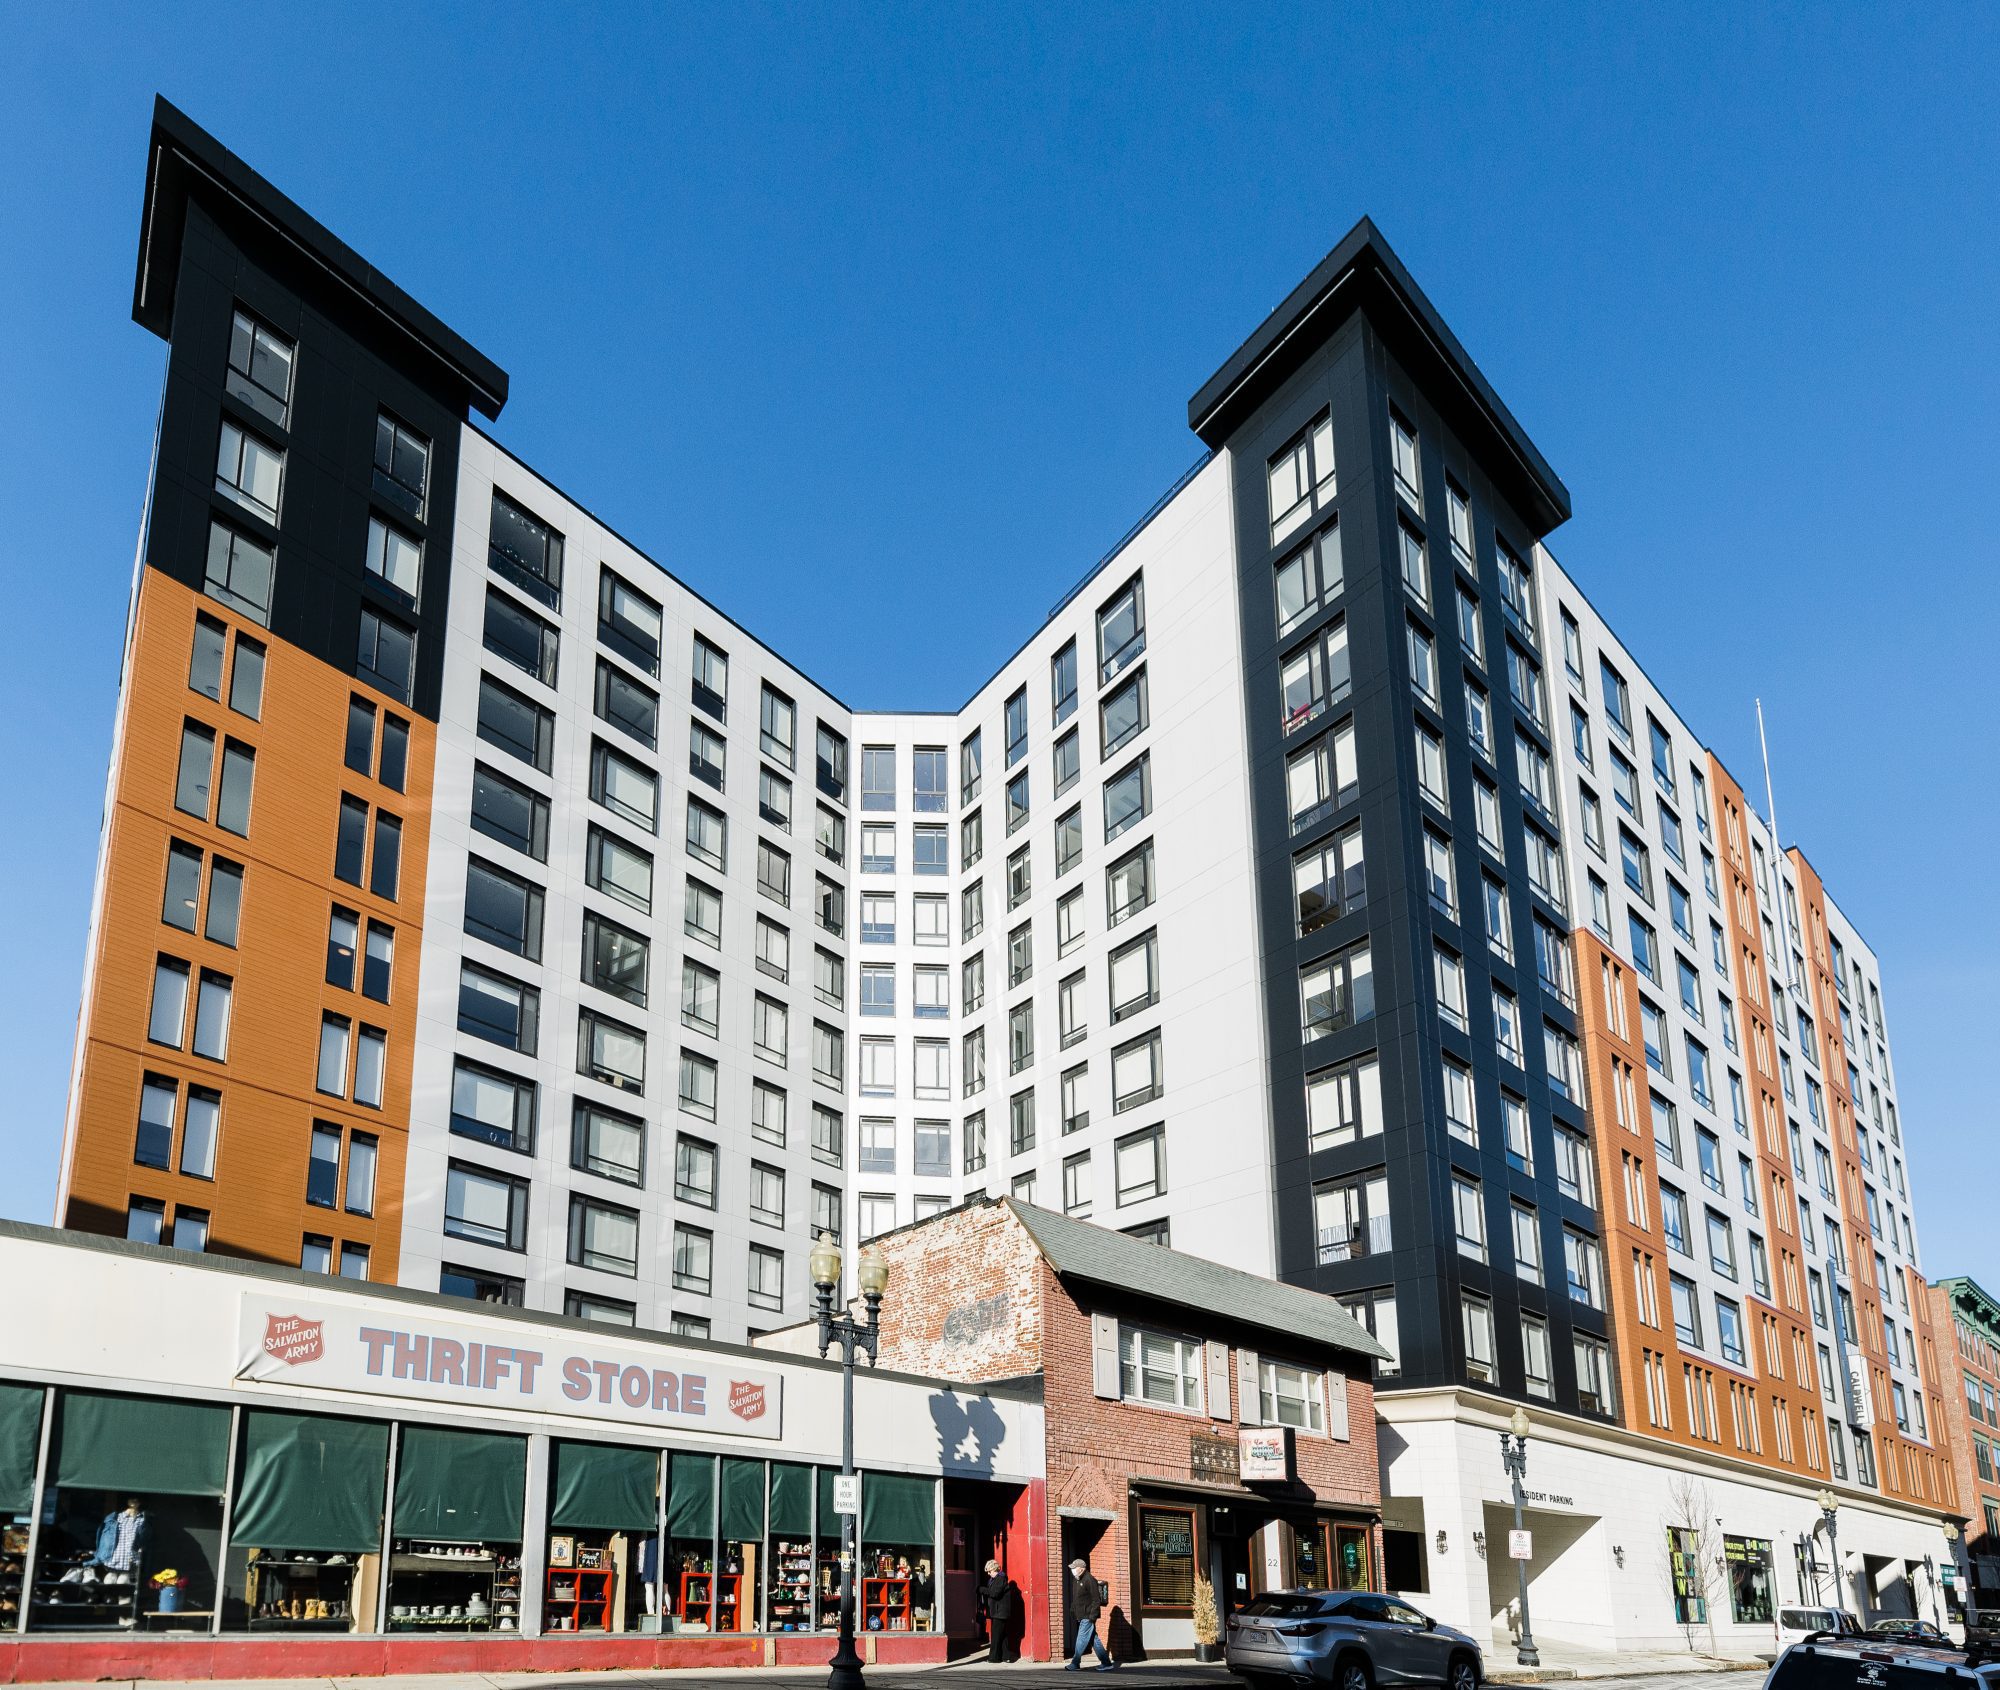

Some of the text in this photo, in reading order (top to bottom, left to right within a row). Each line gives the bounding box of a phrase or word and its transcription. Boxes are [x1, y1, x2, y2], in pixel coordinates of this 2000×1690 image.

[275, 1319, 299, 1334] THE
[265, 1326, 319, 1351] SALVATION
[284, 1340, 318, 1360] ARMY
[359, 1326, 707, 1416] THRIFT STORE
[735, 1384, 750, 1396] THE
[729, 1389, 763, 1410] SALVATION
[1850, 1371, 1865, 1424] CALDWELL
[741, 1400, 762, 1417] ARMY
[839, 1490, 853, 1499] HOUR
[1549, 1494, 1574, 1506] PARKING
[836, 1500, 856, 1509] PARKING
[1168, 1533, 1186, 1543] BUD
[1164, 1542, 1191, 1553] LIGHT
[1267, 1558, 1279, 1568] 22
